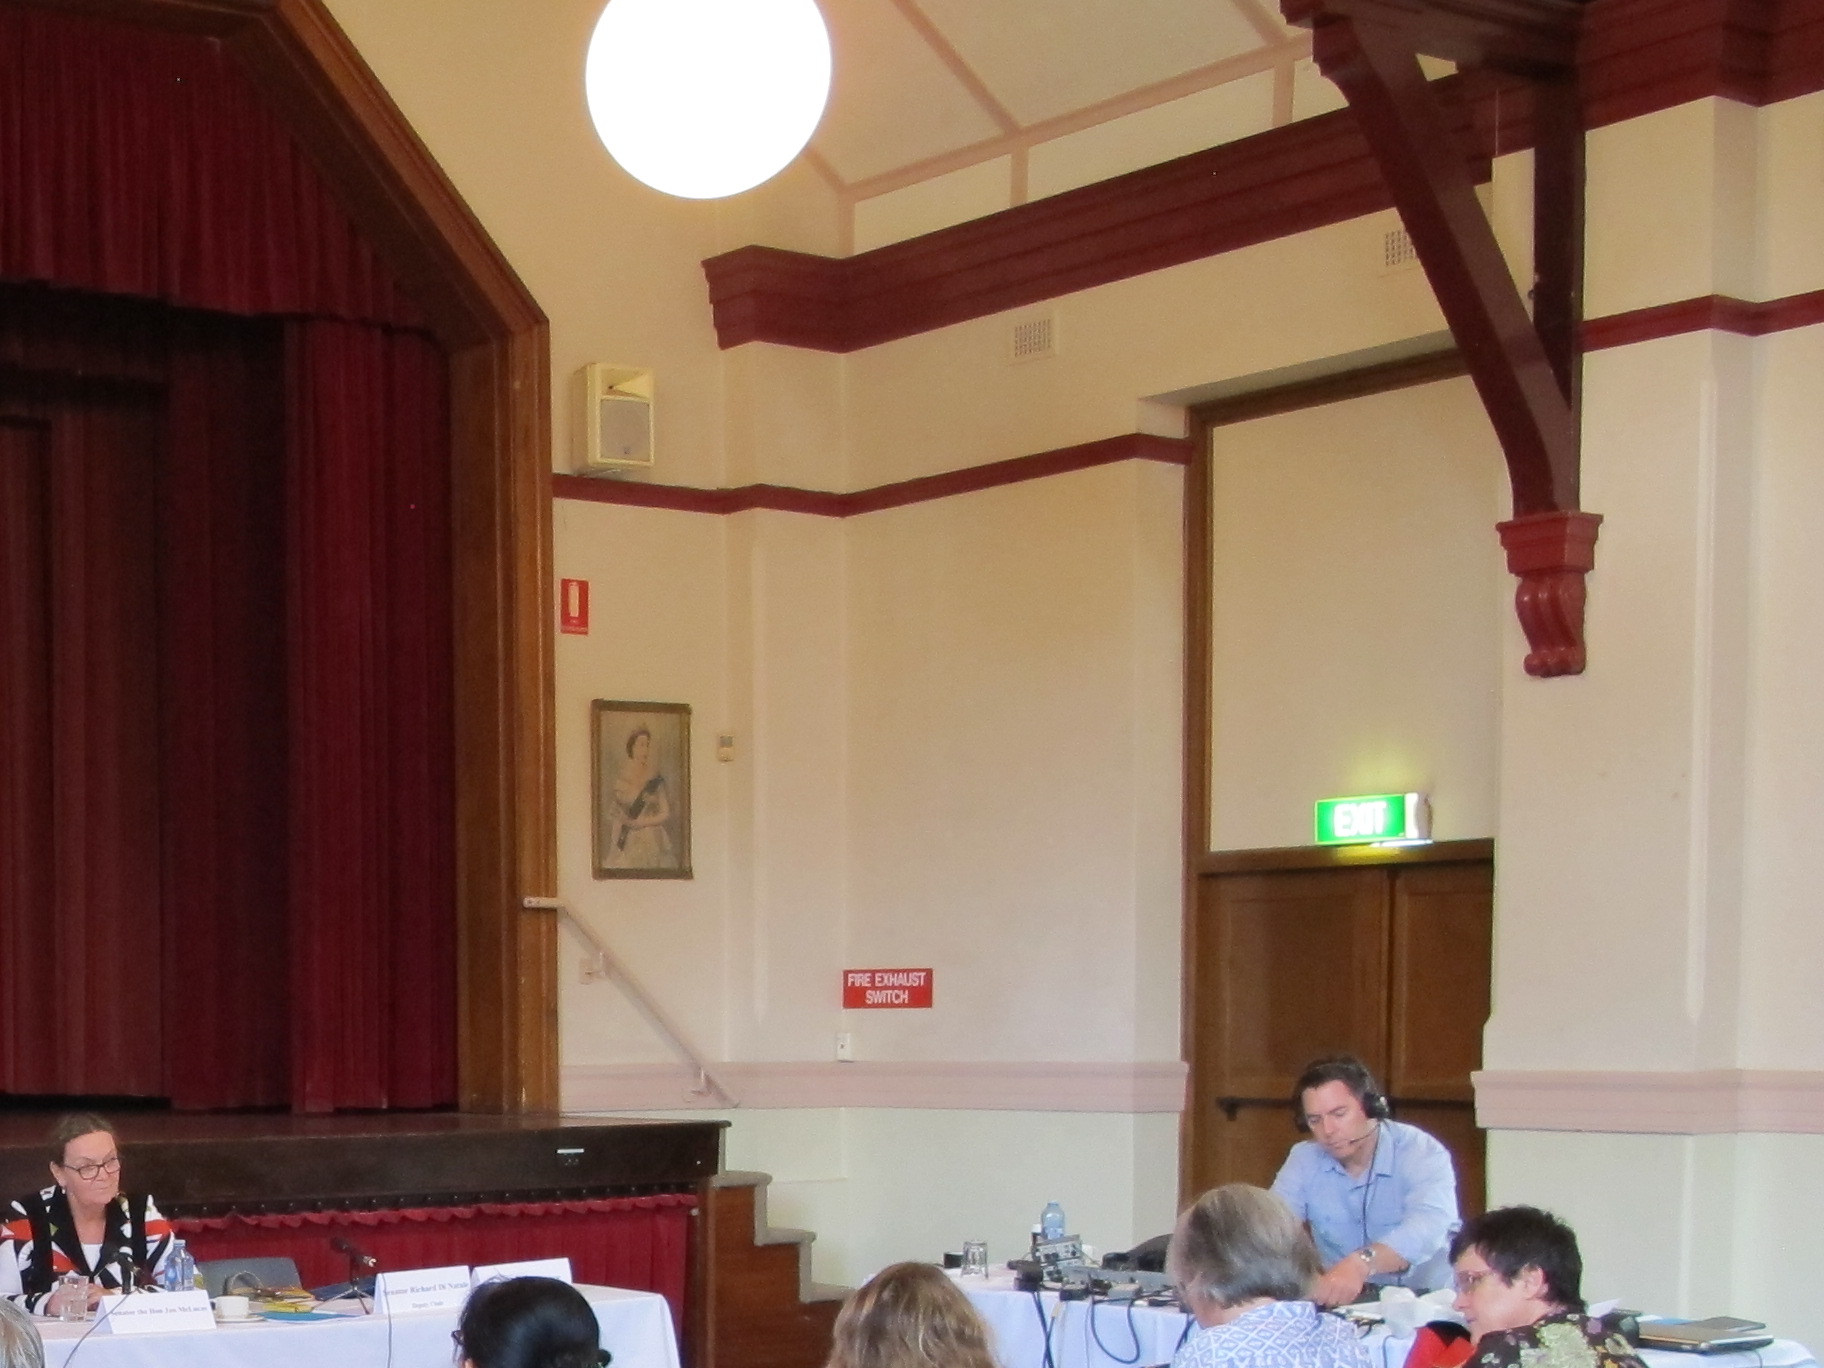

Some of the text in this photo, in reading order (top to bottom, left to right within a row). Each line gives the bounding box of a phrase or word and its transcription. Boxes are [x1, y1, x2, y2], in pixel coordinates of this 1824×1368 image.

[1333, 801, 1387, 837] EXIT
[847, 972, 926, 987] FIRE EXHAUST
[865, 990, 909, 1004] SWITCH
